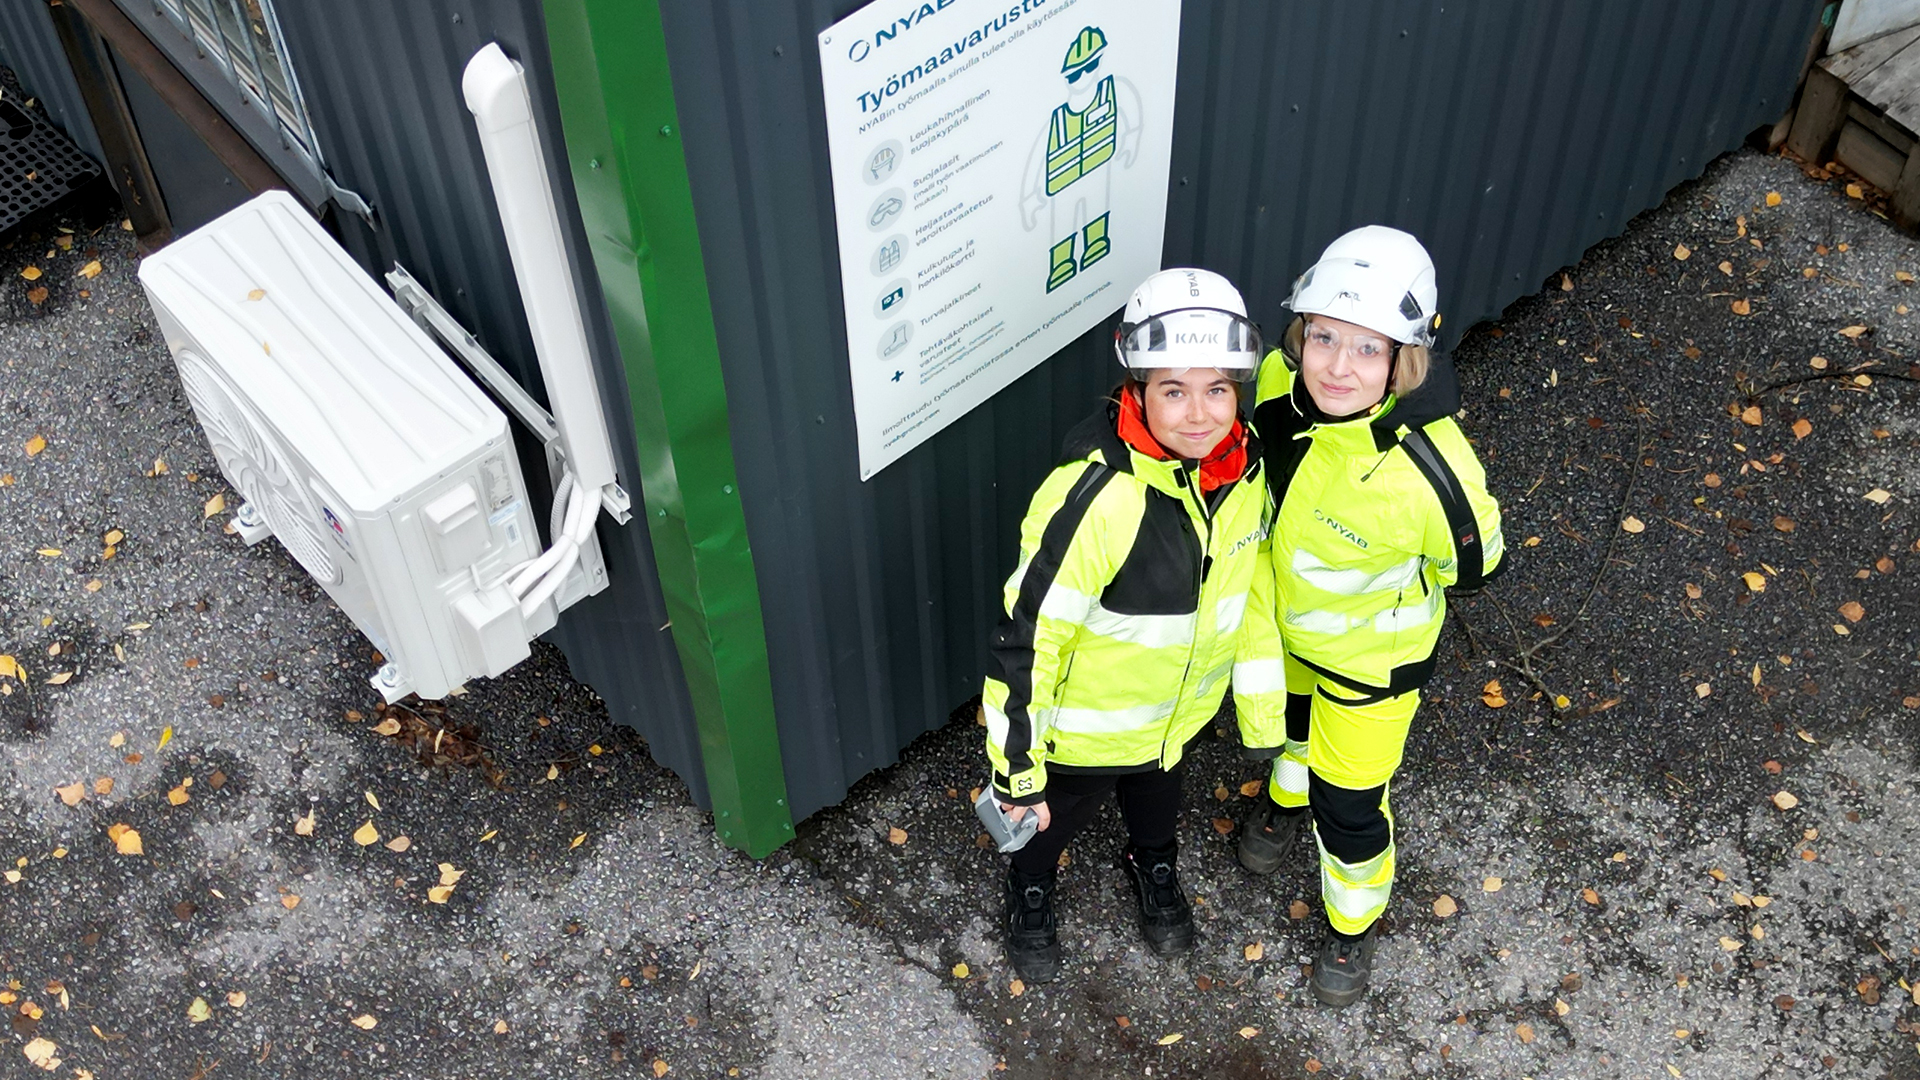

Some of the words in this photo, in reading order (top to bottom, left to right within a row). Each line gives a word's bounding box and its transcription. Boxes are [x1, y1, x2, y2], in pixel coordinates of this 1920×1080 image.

[859, 107, 896, 135] NYABin
[897, 76, 946, 111] työmaalla
[948, 56, 980, 80] sinulla
[981, 40, 1006, 60] tulee
[1007, 29, 1025, 44] olla
[910, 89, 990, 142] Leukahihnallinen
[911, 112, 969, 155] suojakypärä
[913, 154, 960, 188] Suojalasit
[915, 202, 964, 236] Heijastava
[916, 194, 994, 247] varoitusvaatetus
[1175, 332, 1219, 345] KASK
[1236, 530, 1261, 551] NYA
[1326, 517, 1368, 549] NYAB
